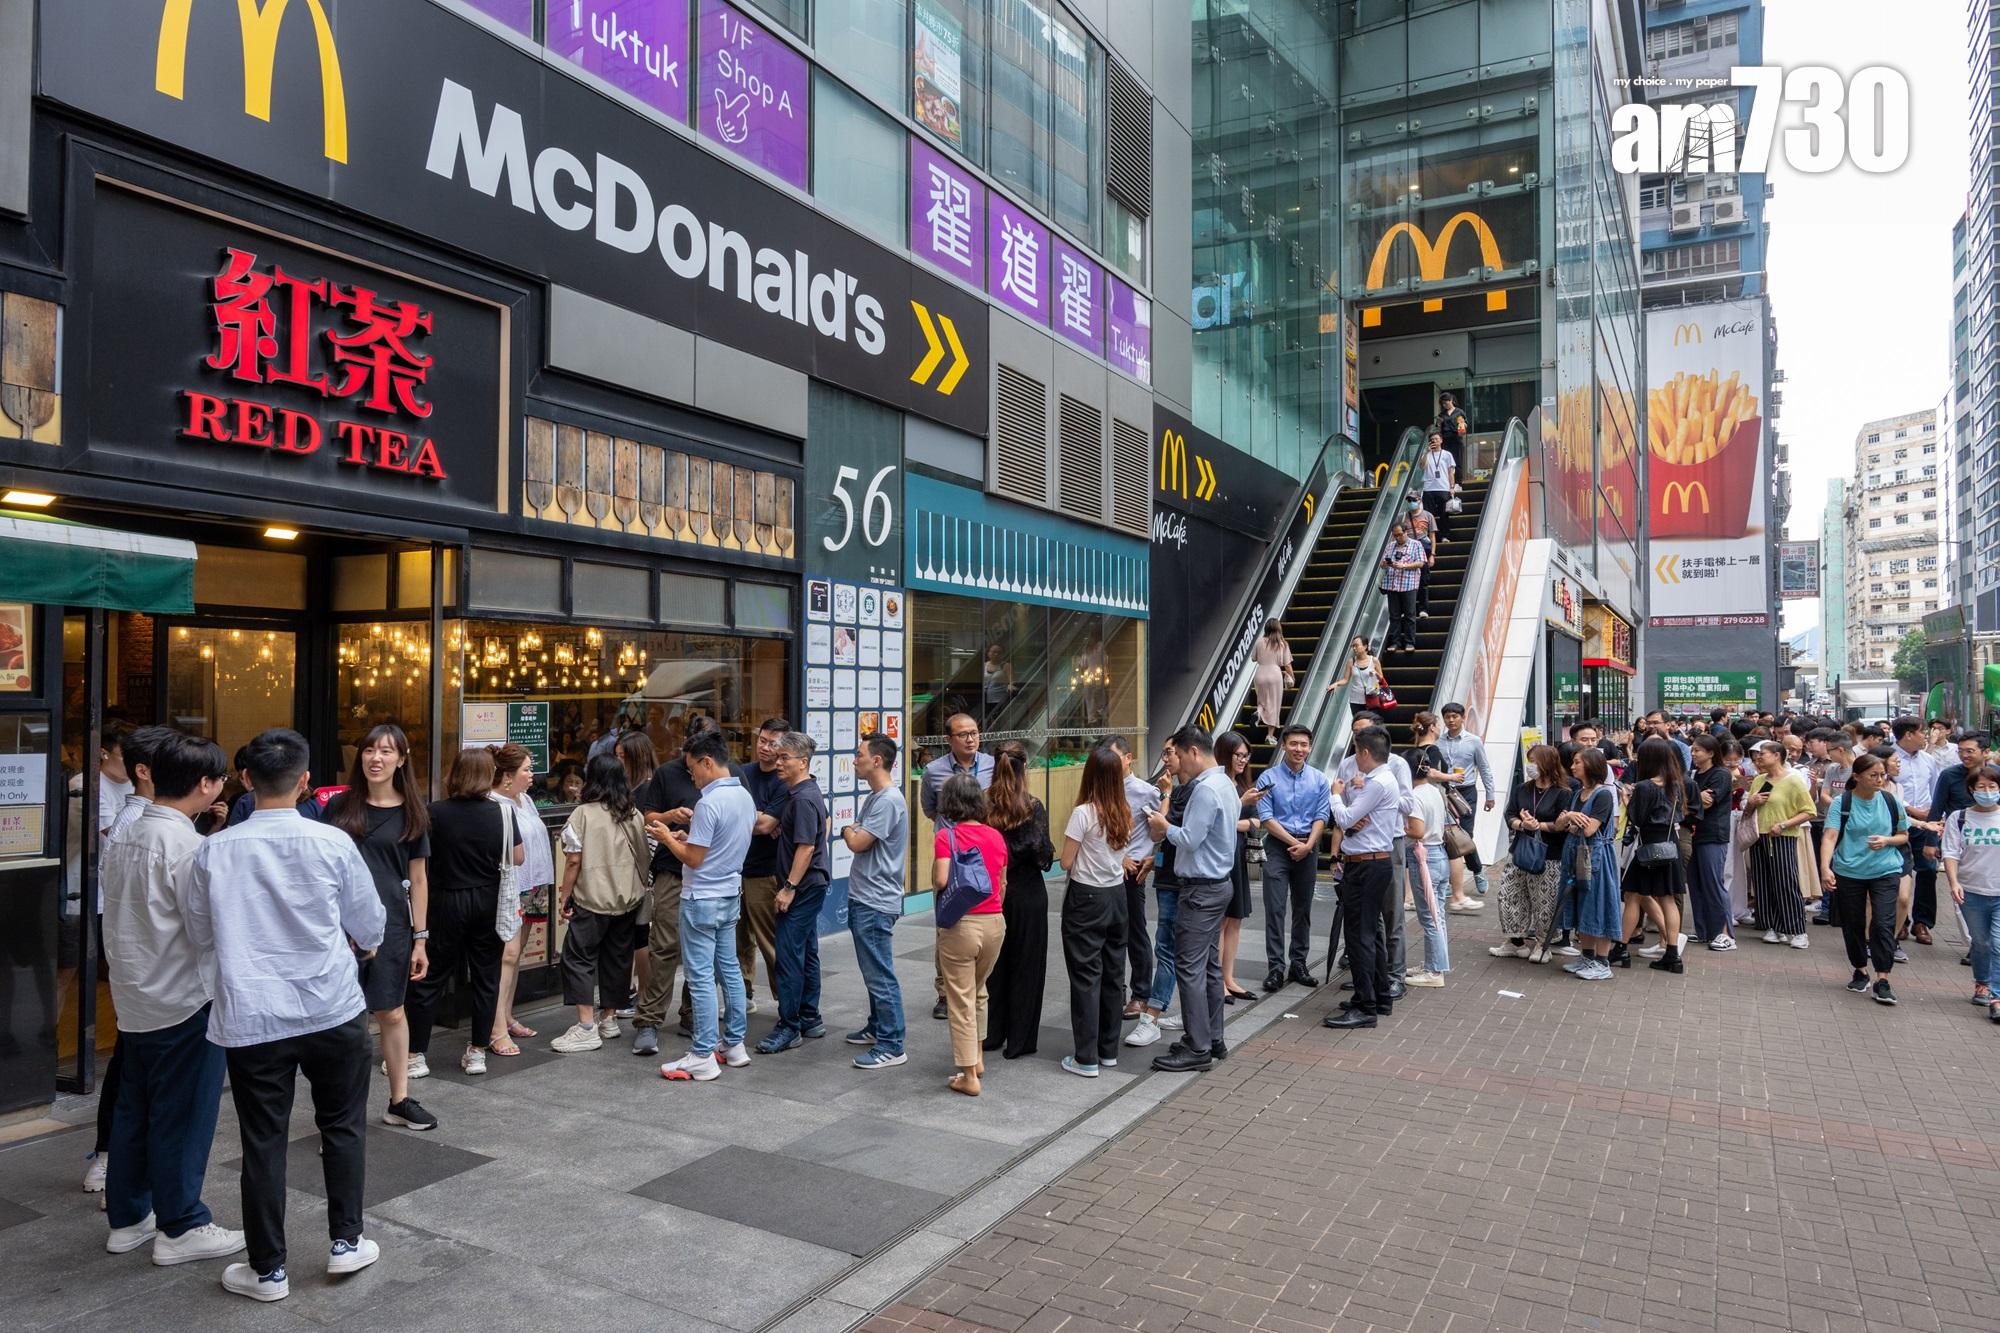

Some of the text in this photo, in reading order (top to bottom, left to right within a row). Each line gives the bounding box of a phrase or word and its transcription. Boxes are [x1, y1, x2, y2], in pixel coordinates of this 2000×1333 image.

[719, 13, 754, 50] 1/F
[718, 49, 793, 119] Shop A
[425, 78, 887, 356] McDonald's
[205, 246, 434, 418] 紅茶
[1713, 320, 1755, 339] McCafé
[180, 390, 449, 480] RED TEA
[823, 464, 897, 552] 56
[1682, 555, 1761, 569] 扶手電梯上一層
[1212, 602, 1265, 714] McDonald's
[7, 792, 28, 801] Only
